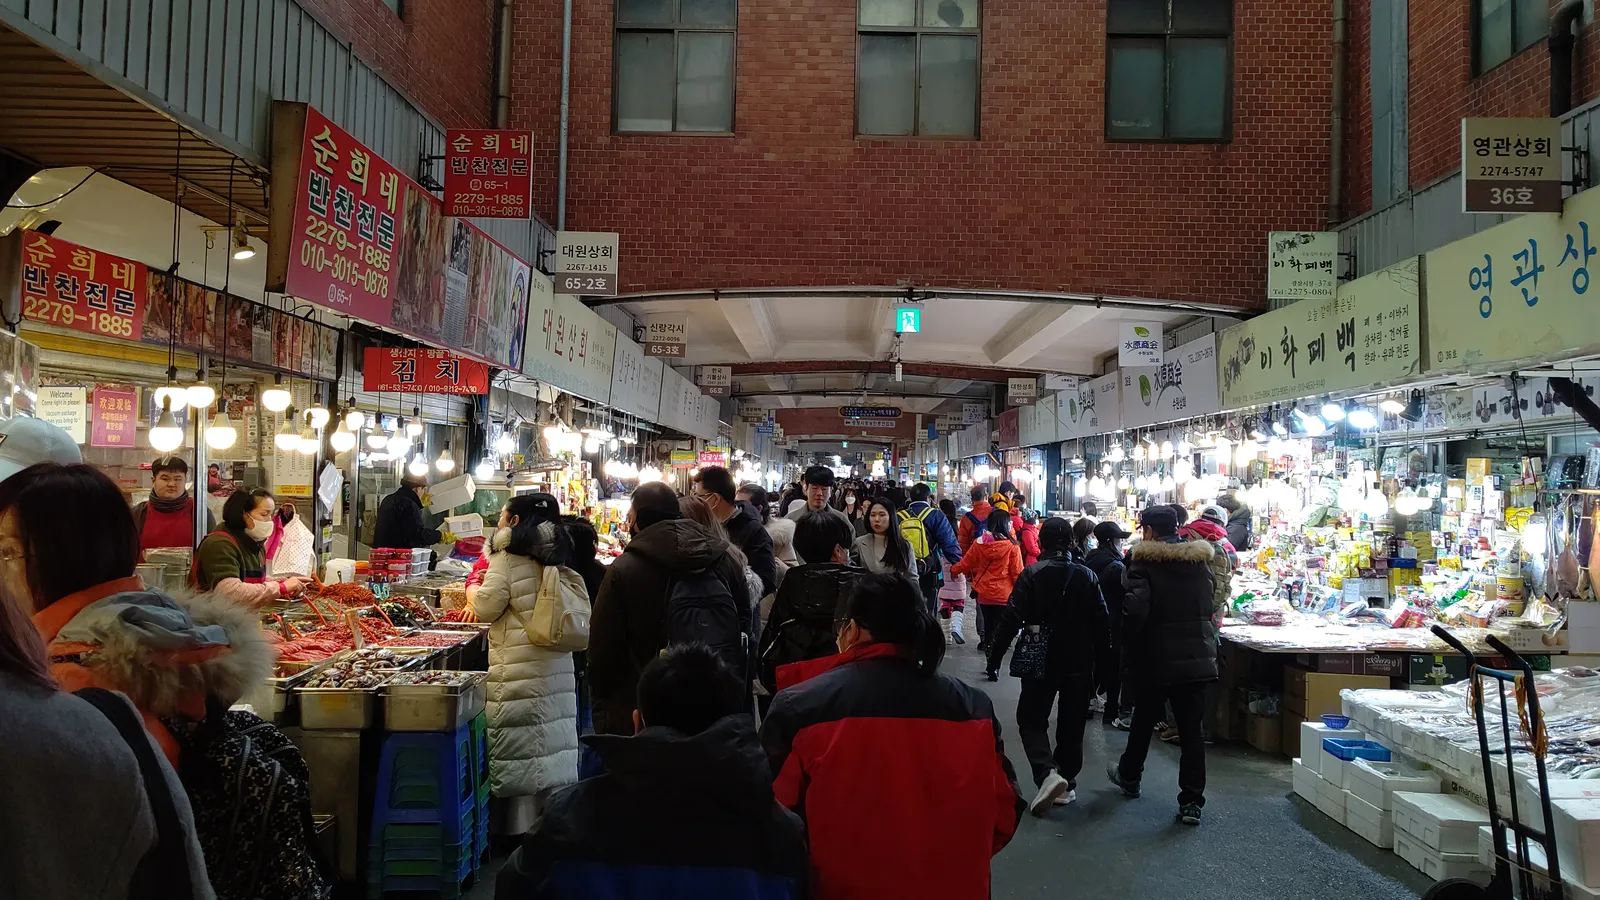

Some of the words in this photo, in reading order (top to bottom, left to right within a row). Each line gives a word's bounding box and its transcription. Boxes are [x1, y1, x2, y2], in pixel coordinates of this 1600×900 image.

[1473, 136, 1551, 157] 영관상회
[452, 157, 528, 176] 반찬전문
[1480, 166, 1544, 176] 2274-5747
[484, 180, 509, 190] 65-1
[454, 193, 523, 205] 2279-1885
[1490, 187, 1534, 205] 36호
[307, 169, 394, 252] 반찬전문
[453, 205, 524, 216] 010-3015-0878
[305, 214, 390, 272] 2279-1885
[563, 245, 613, 259] 대원상회
[301, 239, 389, 299] 010-3015-0878
[566, 263, 608, 272] 2267-1415
[24, 264, 136, 316] 반찬전문
[565, 278, 607, 290] 65-2호
[24, 296, 132, 337] 2279-1885
[650, 323, 684, 334] 신랑각시
[543, 308, 588, 367] 대원상회
[651, 345, 680, 355] 65-3호
[391, 357, 460, 385] 김치
[50, 390, 73, 398] Welcome
[53, 399, 63, 407] right
